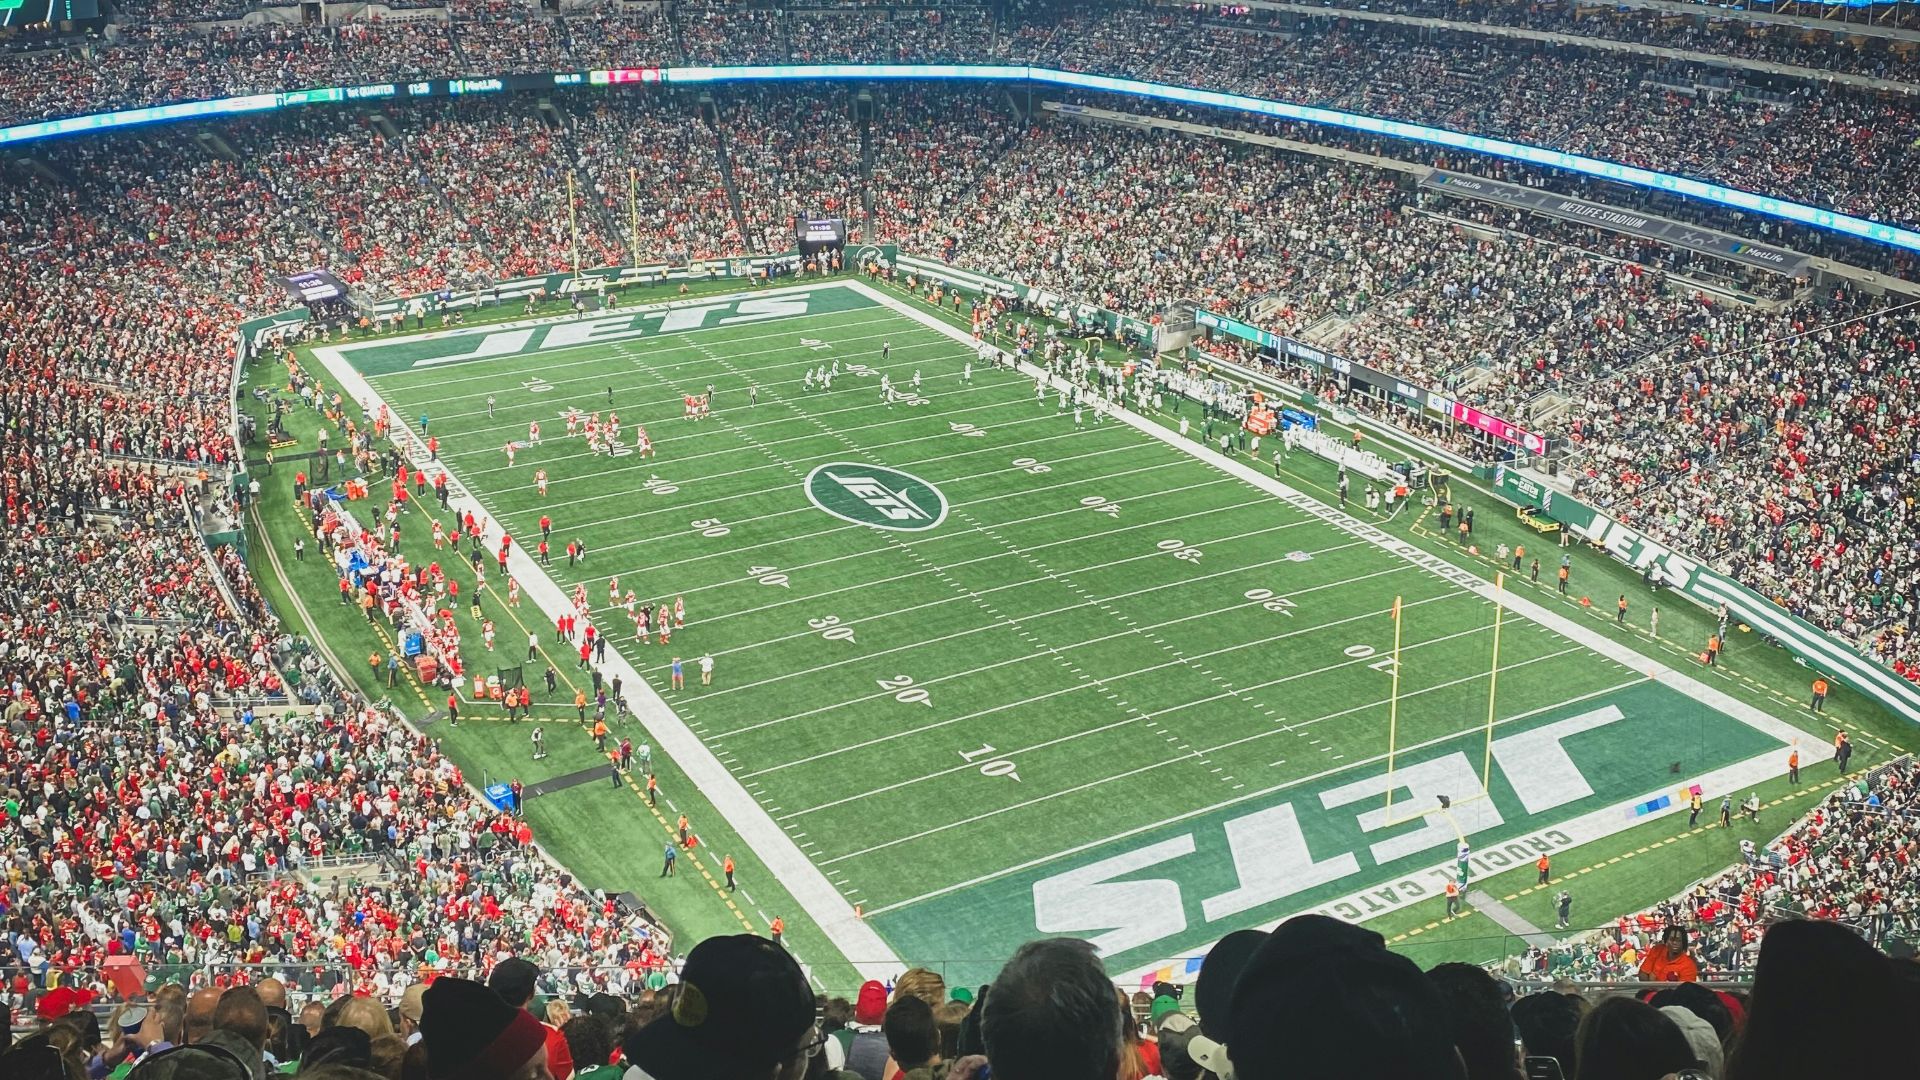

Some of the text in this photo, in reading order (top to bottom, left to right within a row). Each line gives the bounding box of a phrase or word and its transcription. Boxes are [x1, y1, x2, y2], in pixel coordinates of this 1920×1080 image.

[360, 84, 395, 96] QUARTER
[1451, 178, 1482, 190] MetLife
[1557, 201, 1648, 229] METLIFE STADIUM
[1745, 247, 1784, 263] MetLife
[411, 291, 812, 368] JETS
[1011, 457, 1053, 475] 50
[641, 476, 681, 495] 40
[824, 471, 933, 521] JETS
[1080, 495, 1123, 516] 40
[690, 517, 731, 538] 50
[1156, 539, 1204, 562] 30
[1286, 494, 1487, 589] INTERCEPT CANCER
[1569, 513, 1699, 591] JETS
[746, 565, 790, 587] 40
[1243, 588, 1299, 613] 20
[807, 615, 856, 641] 30
[1343, 644, 1403, 677] 10
[876, 674, 930, 703] 20
[957, 743, 1017, 777] 10
[1032, 704, 1627, 960] JETS
